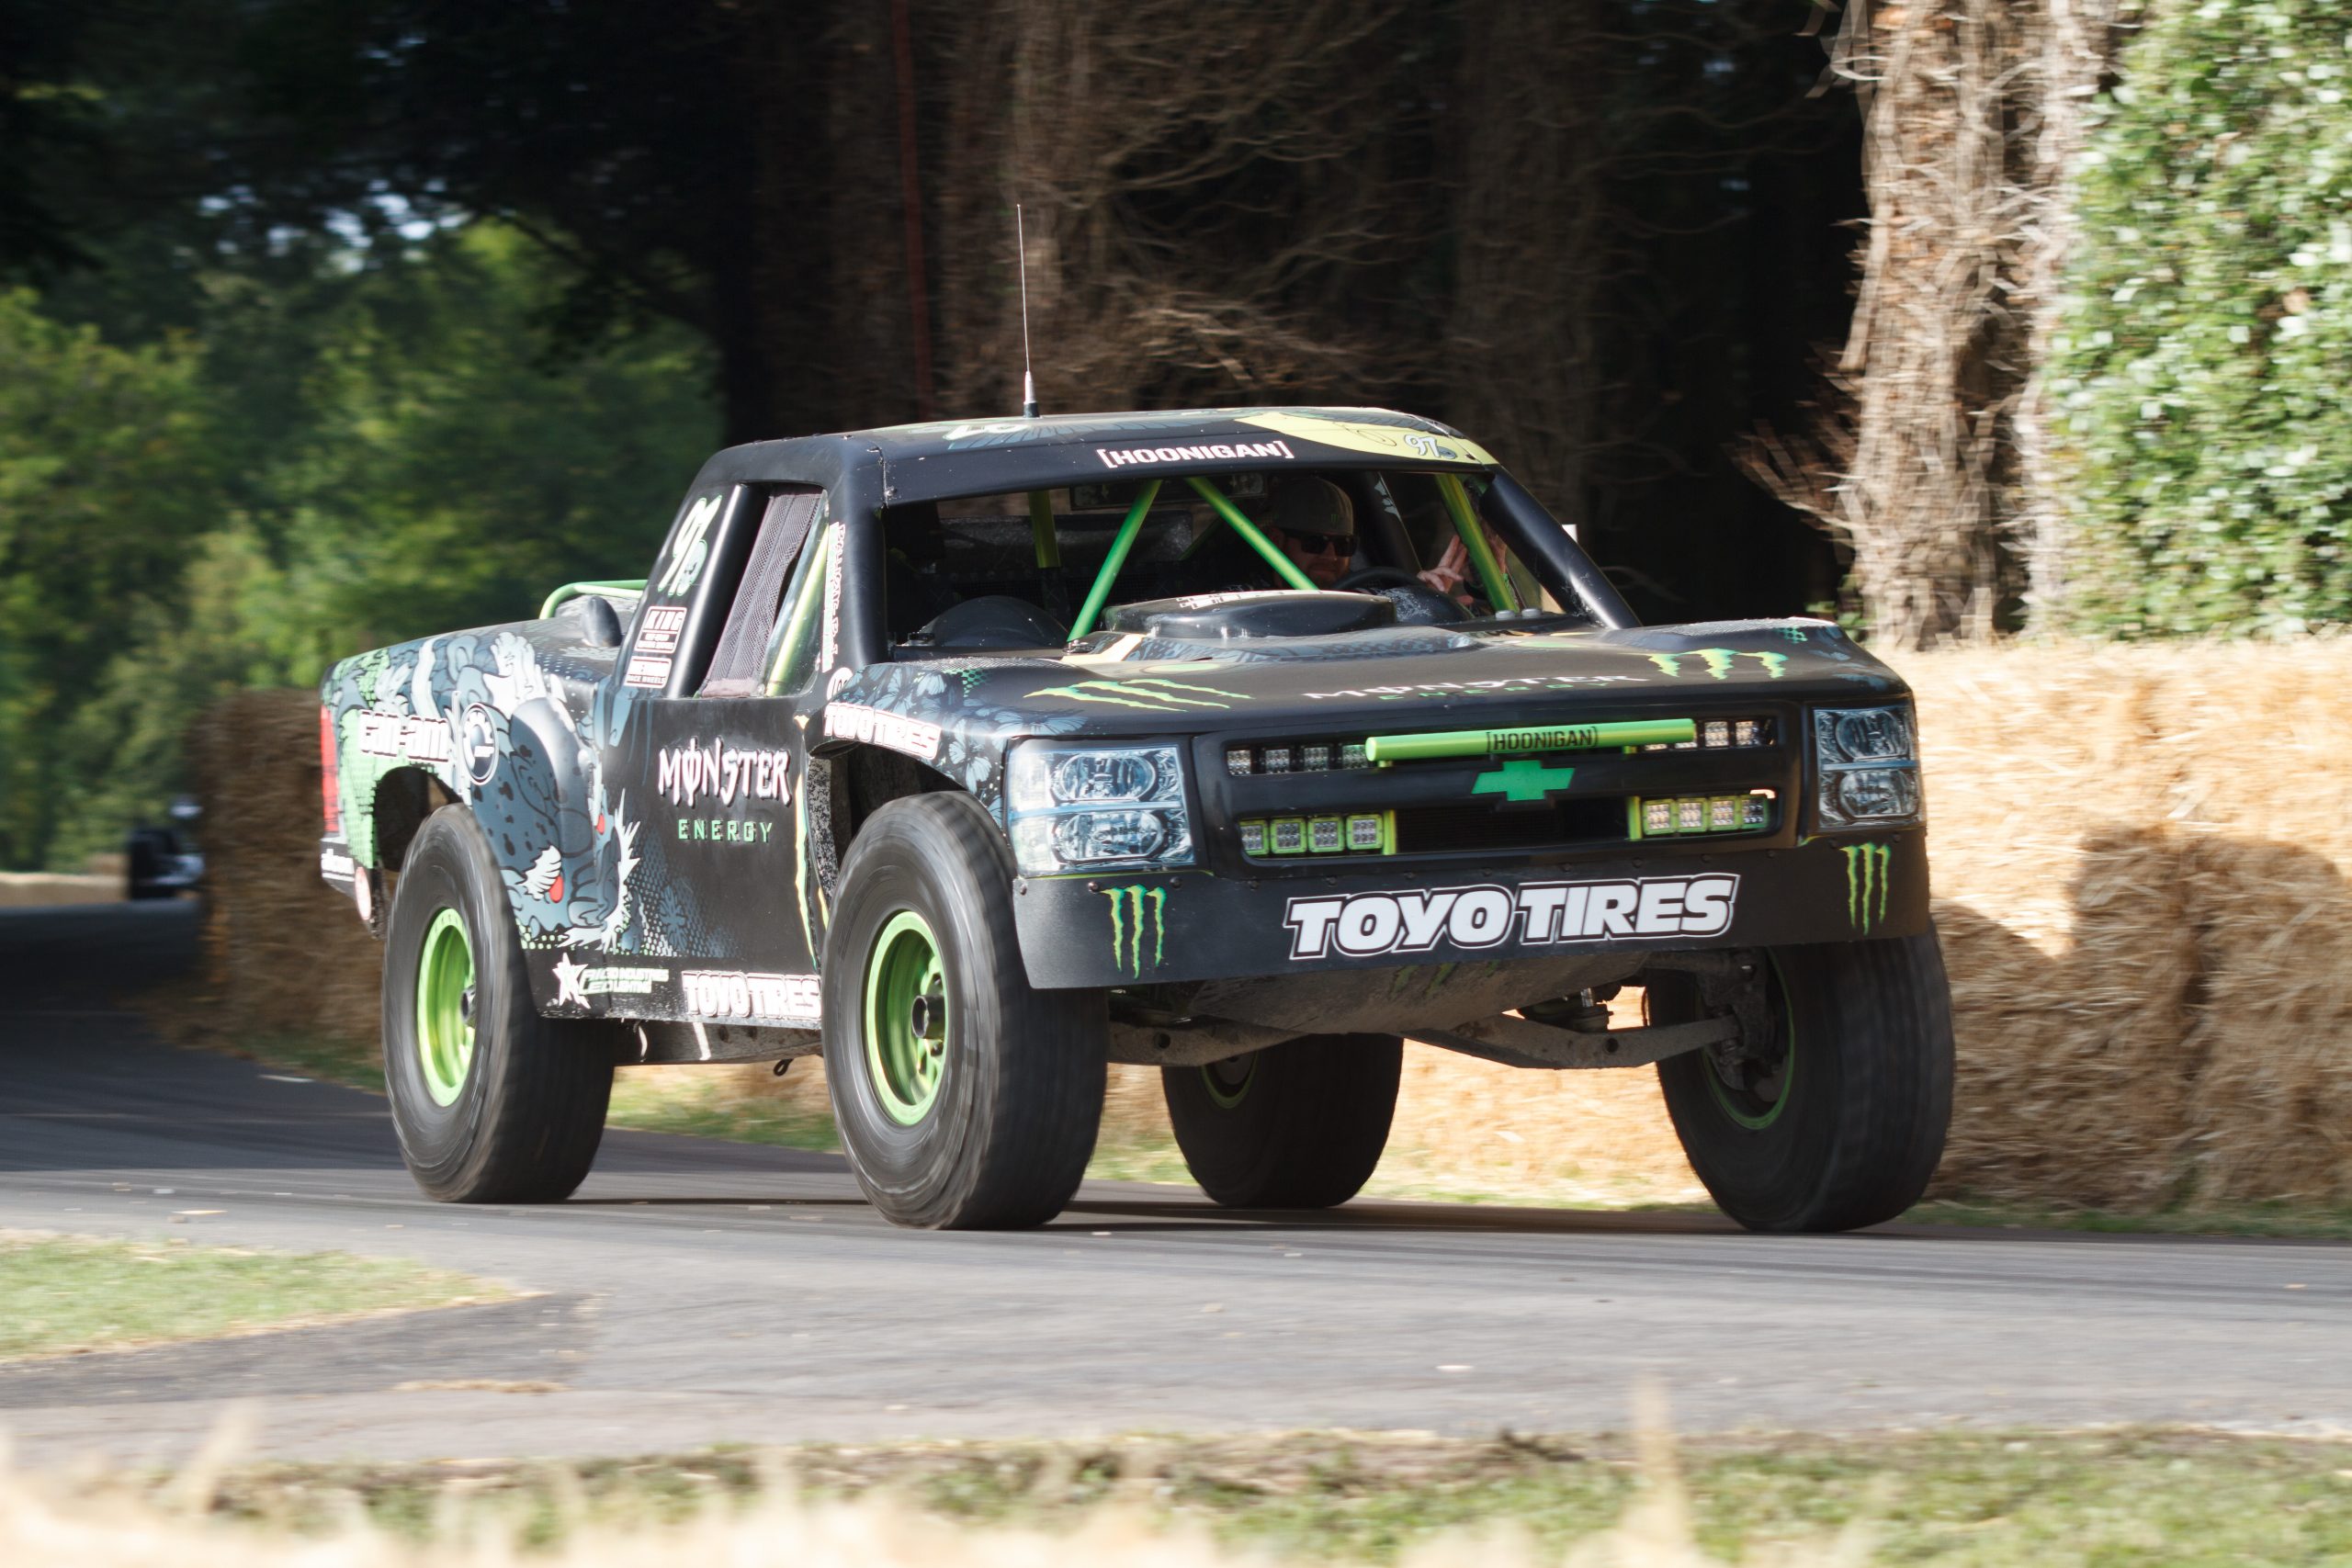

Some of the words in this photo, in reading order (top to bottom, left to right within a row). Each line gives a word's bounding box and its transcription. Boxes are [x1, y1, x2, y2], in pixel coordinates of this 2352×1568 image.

[1096, 440, 1295, 468] [HOONIGAN]
[1302, 675, 1651, 699] MONSTER
[1378, 682, 1610, 701] ENERGY
[1486, 726, 1599, 753] [HOONIGAN]
[658, 736, 793, 808] MONSTER
[678, 818, 774, 843] ENERGY
[1283, 883, 1515, 961] TOYO
[1515, 873, 1741, 946] TIRES
